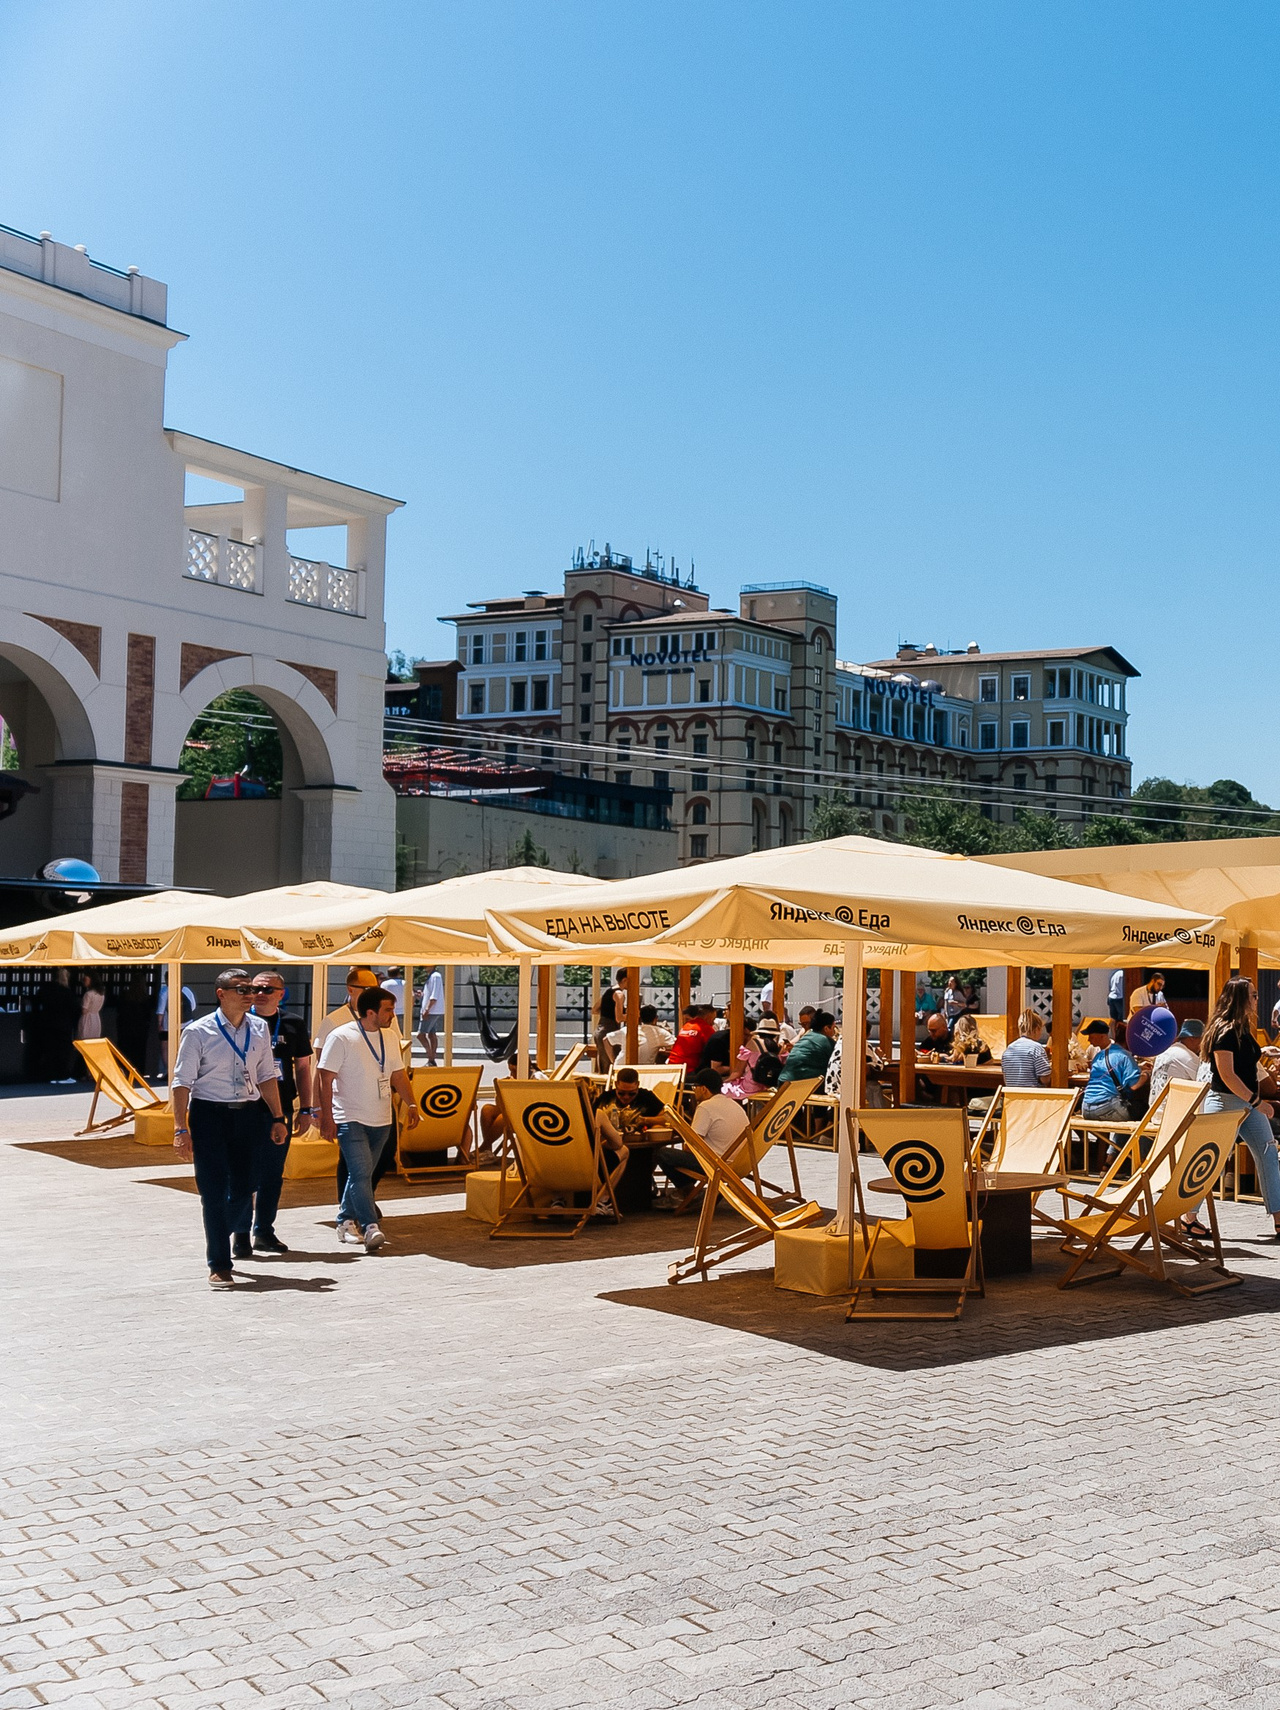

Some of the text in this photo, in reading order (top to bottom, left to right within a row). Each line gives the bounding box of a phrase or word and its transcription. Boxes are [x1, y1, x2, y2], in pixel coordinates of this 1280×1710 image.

[630, 650, 712, 666] NOVOTEL
[864, 677, 935, 708] NOVOTEL
[545, 910, 671, 938] ЕДА НА ВЫСОТЕ
[769, 902, 890, 930] Яндекс Еда
[957, 914, 1067, 936] Яндекс Еда
[1122, 925, 1216, 948] Яндекс Еда
